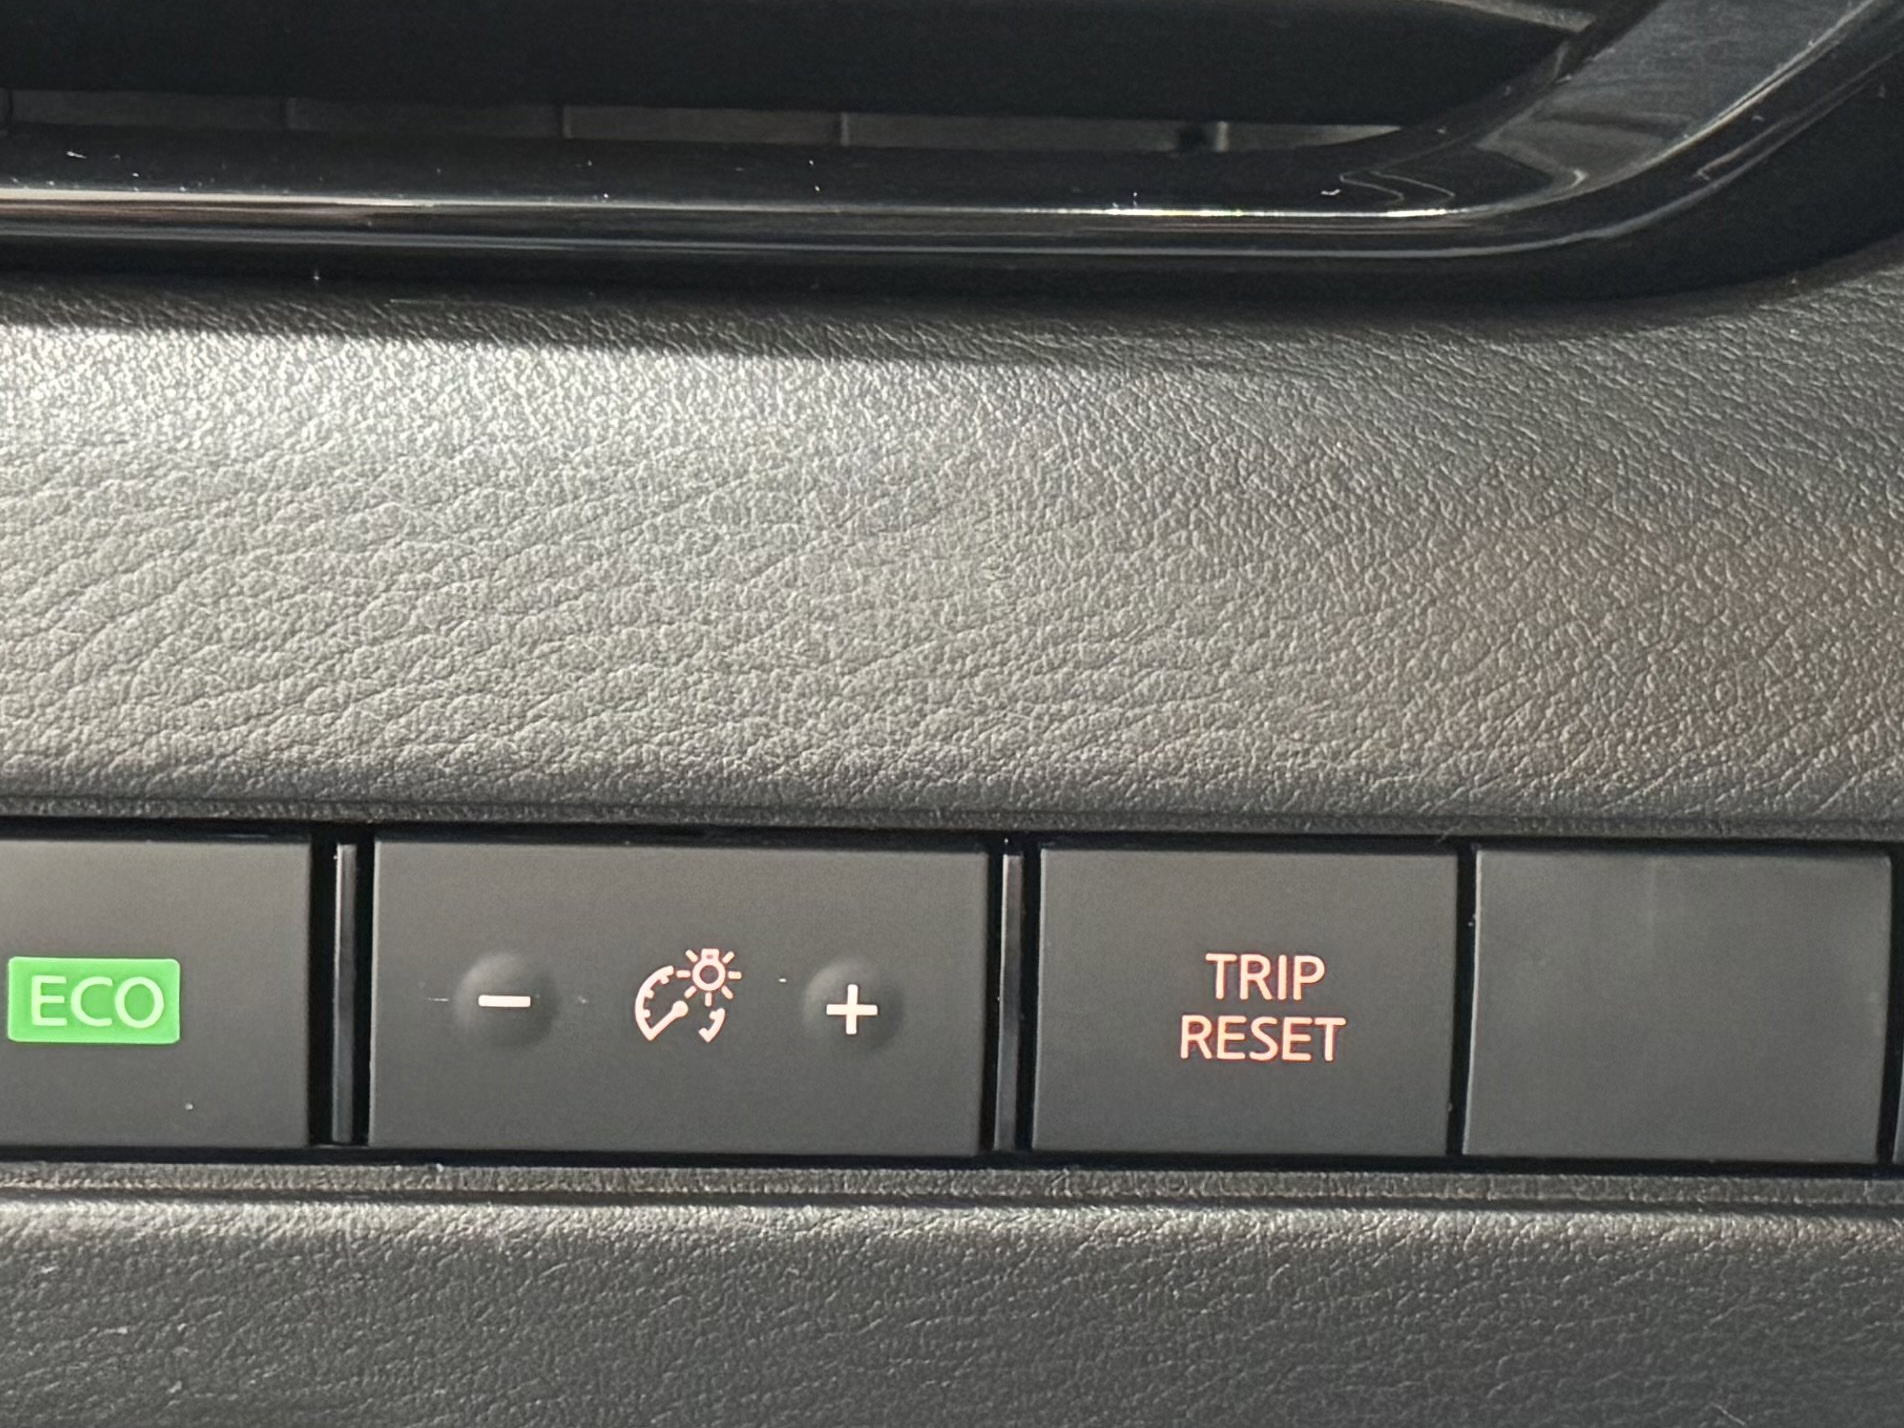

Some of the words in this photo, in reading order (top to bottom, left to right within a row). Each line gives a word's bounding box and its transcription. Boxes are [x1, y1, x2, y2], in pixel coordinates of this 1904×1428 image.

[1205, 952, 1325, 1001] TRIP
[31, 974, 164, 1029] ECO
[1179, 1014, 1347, 1062] RESET
